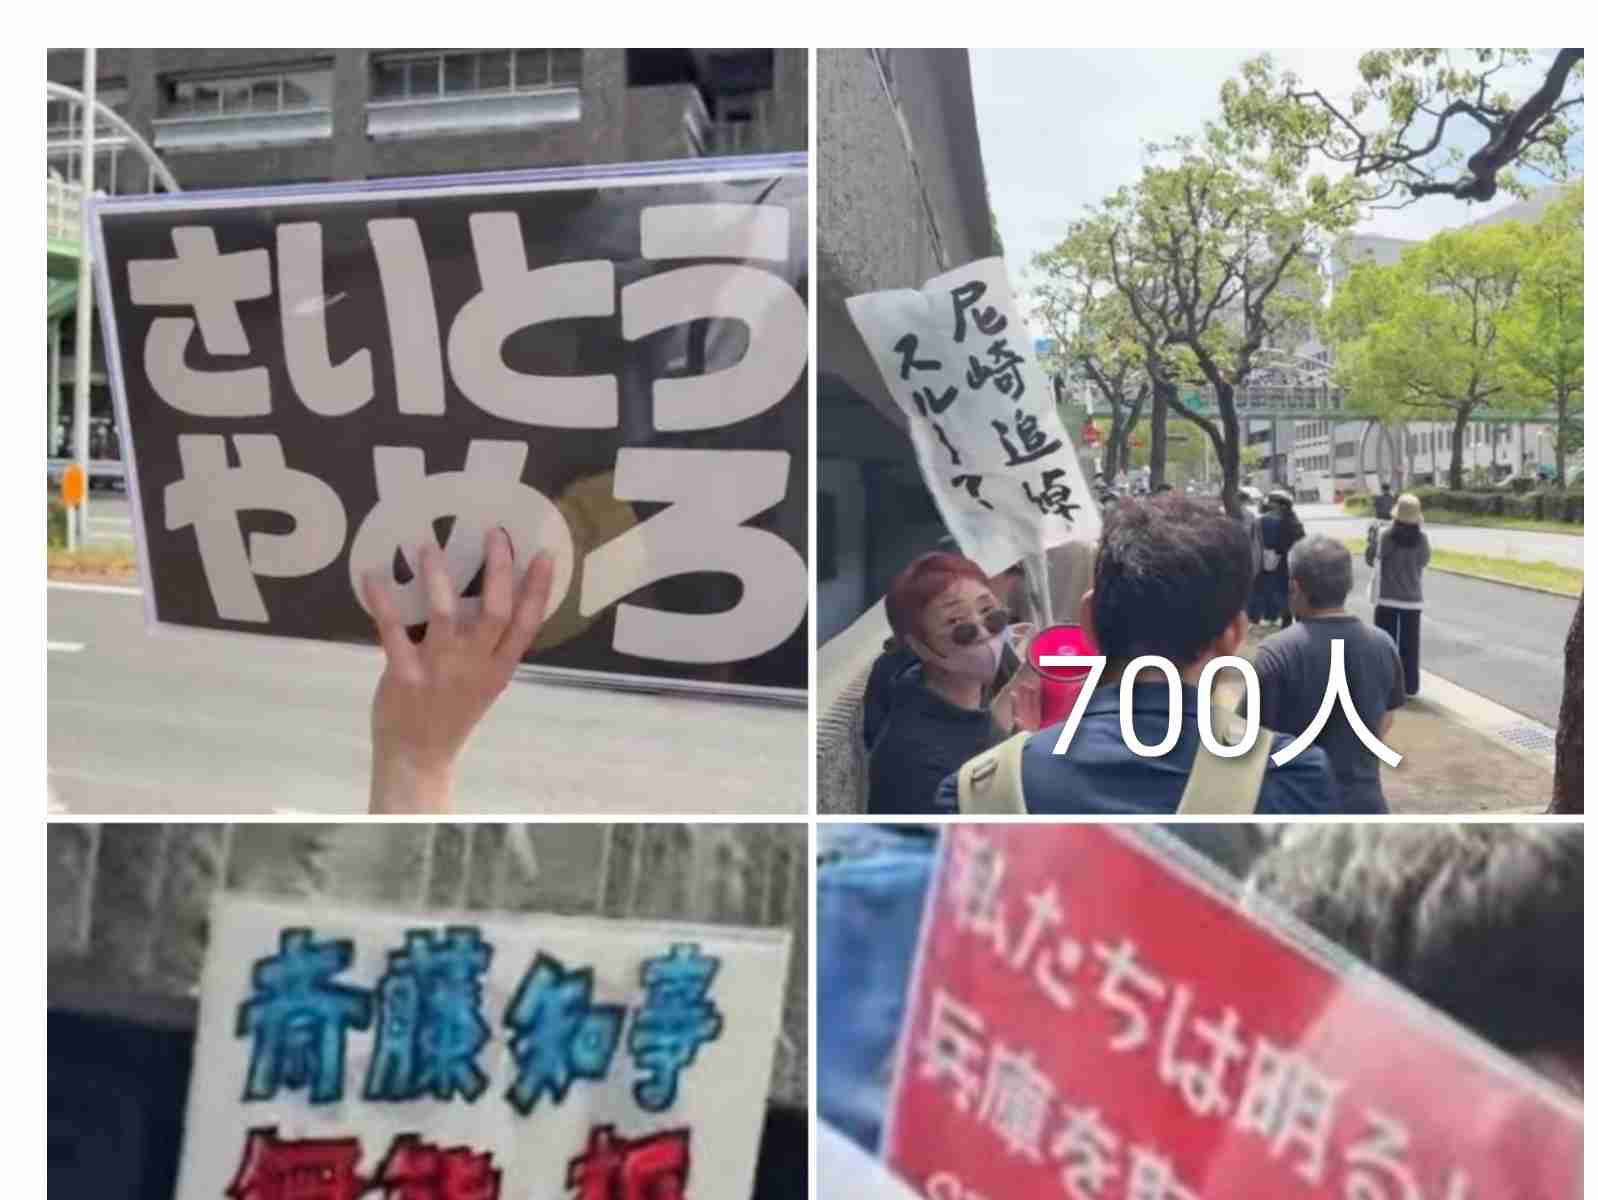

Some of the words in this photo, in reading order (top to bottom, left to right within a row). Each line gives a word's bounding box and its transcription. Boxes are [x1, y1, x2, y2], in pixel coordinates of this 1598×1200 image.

[127, 202, 808, 431] さいとう
[950, 280, 1081, 523] 尼崎追悼
[164, 433, 808, 664] やめろ
